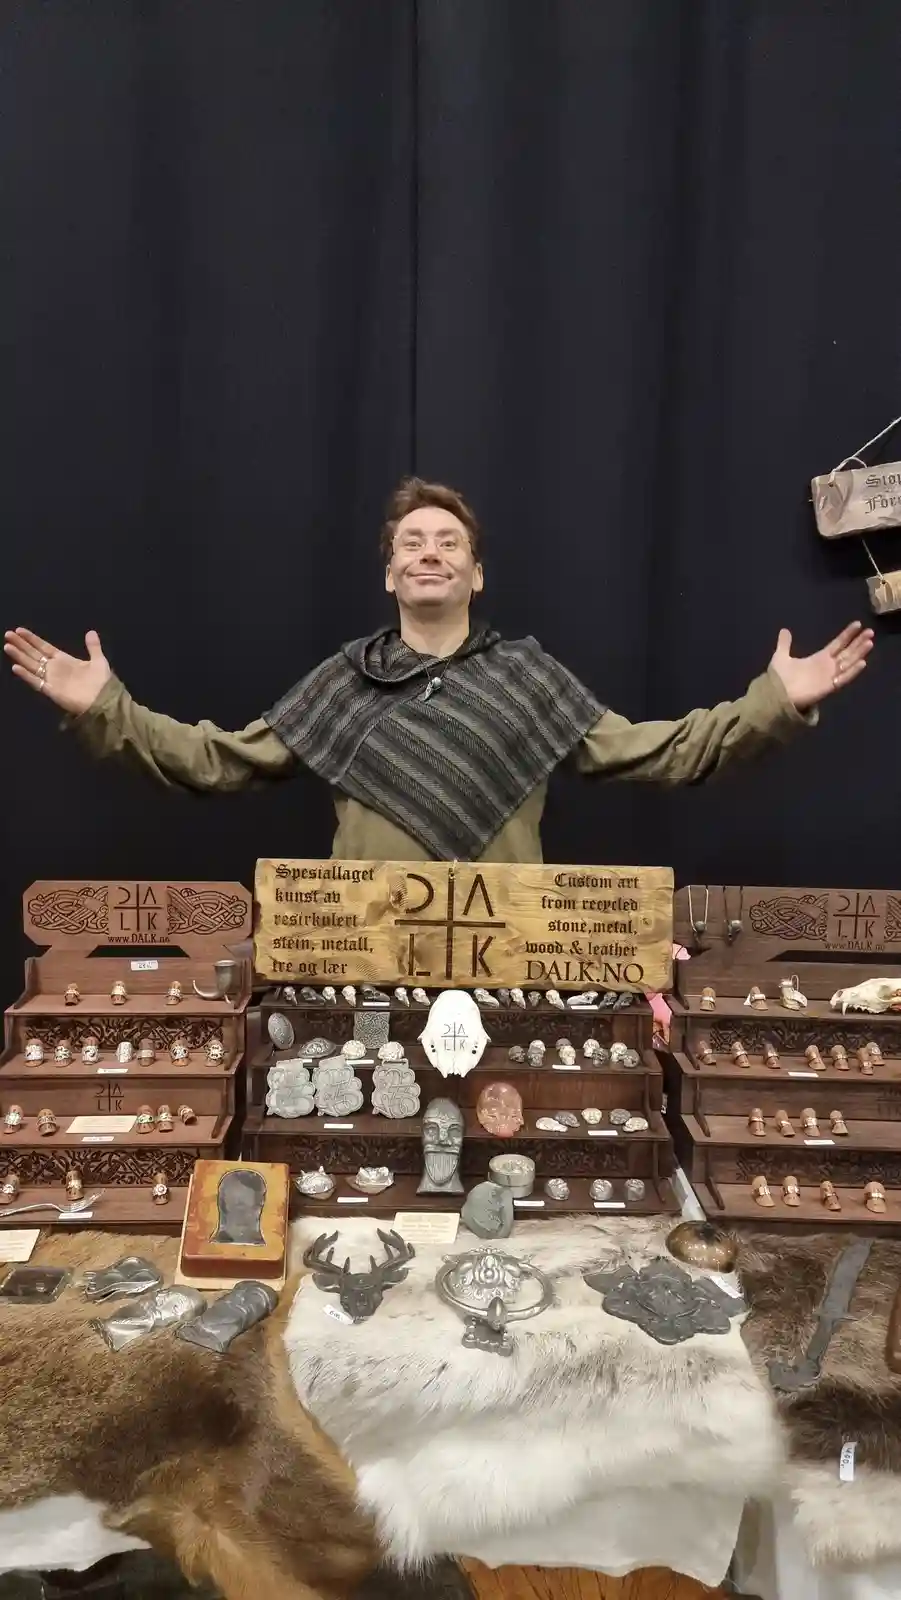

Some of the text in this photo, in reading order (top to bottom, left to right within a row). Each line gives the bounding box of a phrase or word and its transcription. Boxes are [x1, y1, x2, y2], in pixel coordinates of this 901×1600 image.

[275, 864, 376, 883] Spesiallaget
[554, 873, 639, 889] Custom art
[275, 888, 341, 904] kunst av
[541, 896, 638, 914] from recycled
[273, 912, 358, 928] resirkulert
[272, 936, 374, 954] stein, metall,
[525, 940, 638, 958] wood & leather
[272, 958, 348, 977] tre og lær
[524, 960, 644, 984] DALK.NO
